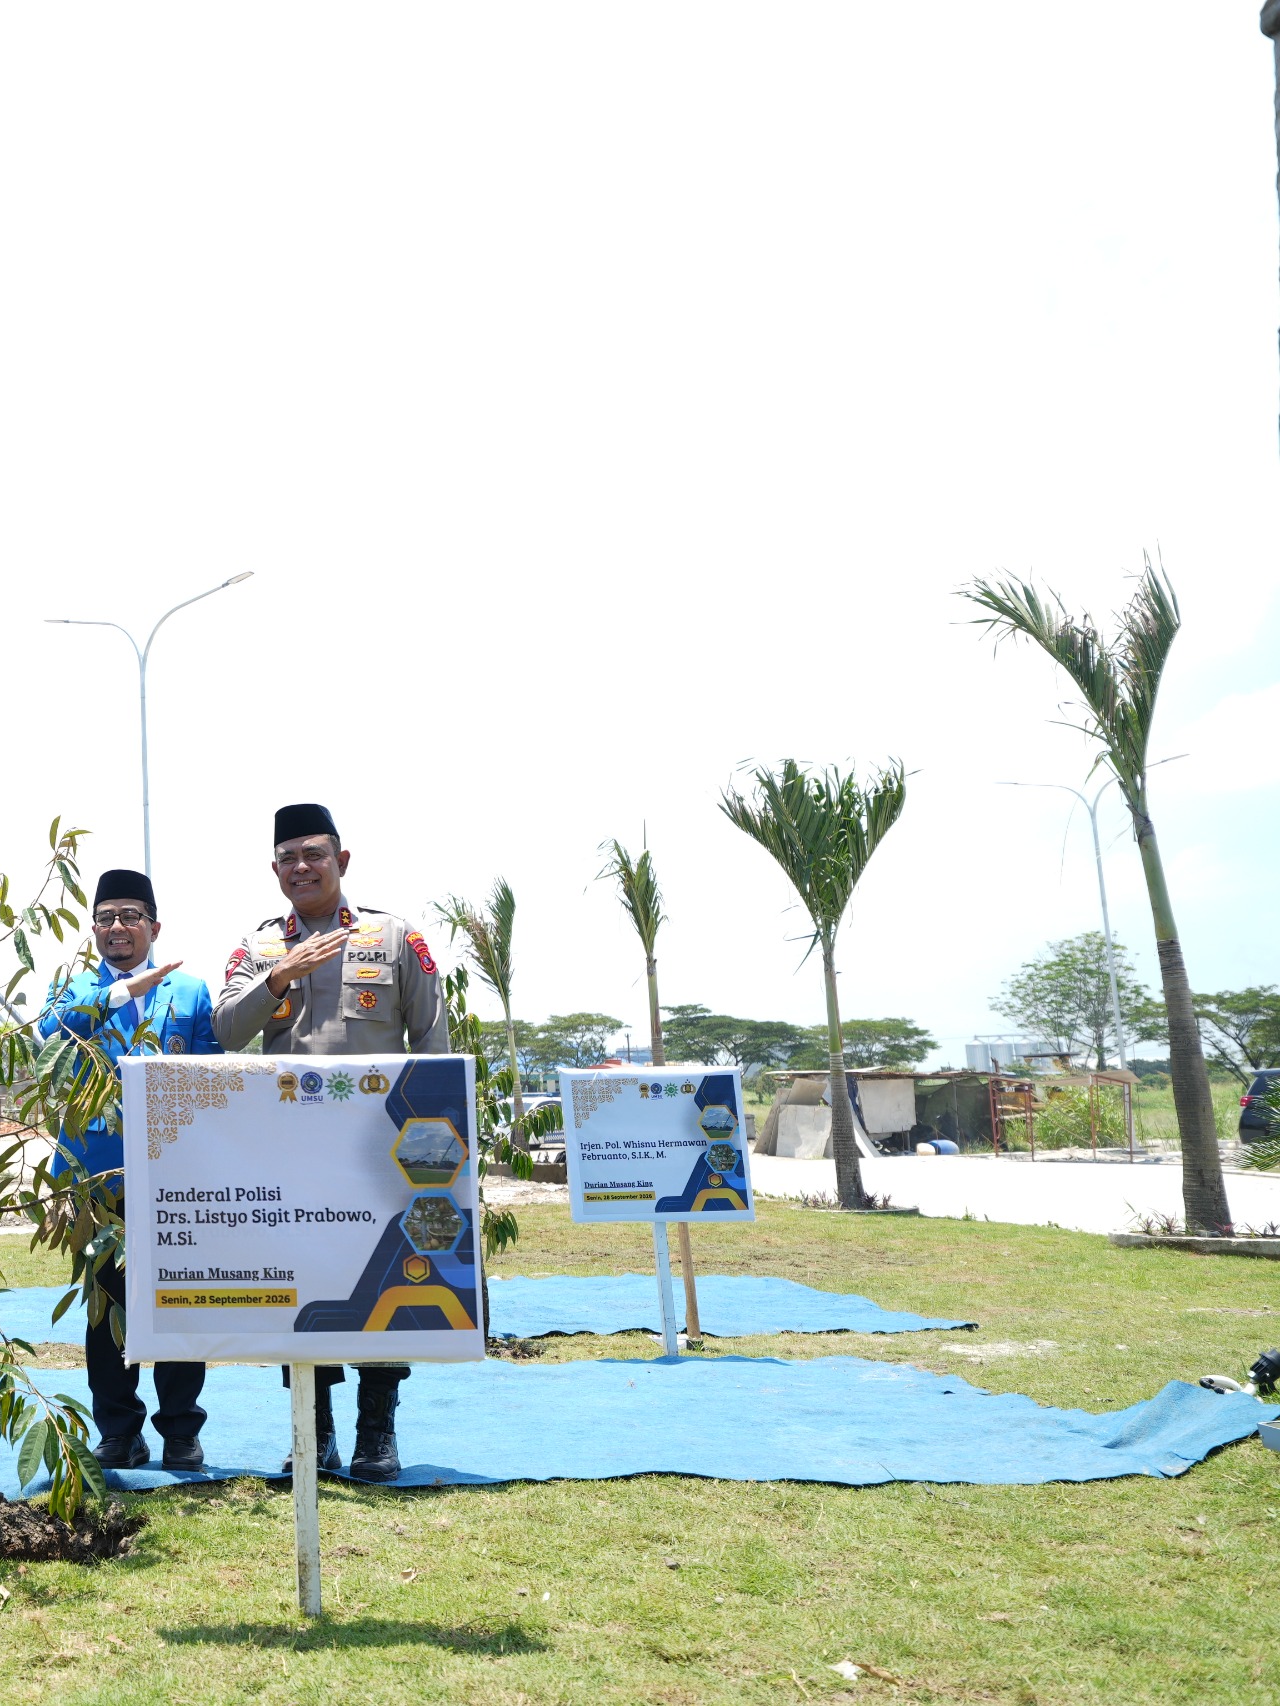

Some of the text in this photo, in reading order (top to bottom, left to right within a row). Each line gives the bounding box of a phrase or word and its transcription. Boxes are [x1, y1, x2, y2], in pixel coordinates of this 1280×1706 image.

[347, 951, 386, 962] POLRI
[580, 1139, 707, 1151] Irjen. Pol. Whisnu Hermawan
[581, 1152, 630, 1161] Februanto,
[656, 1151, 666, 1159] M.
[584, 1181, 608, 1189] Durian
[155, 1186, 282, 1203] Jenderal Polisi
[156, 1207, 377, 1228] Drs. Listyo Sigit Prabowo,
[157, 1231, 197, 1246] M.Si.
[158, 1266, 295, 1281] Durian Musang King
[161, 1294, 291, 1306] Senin, 28 September 2026
